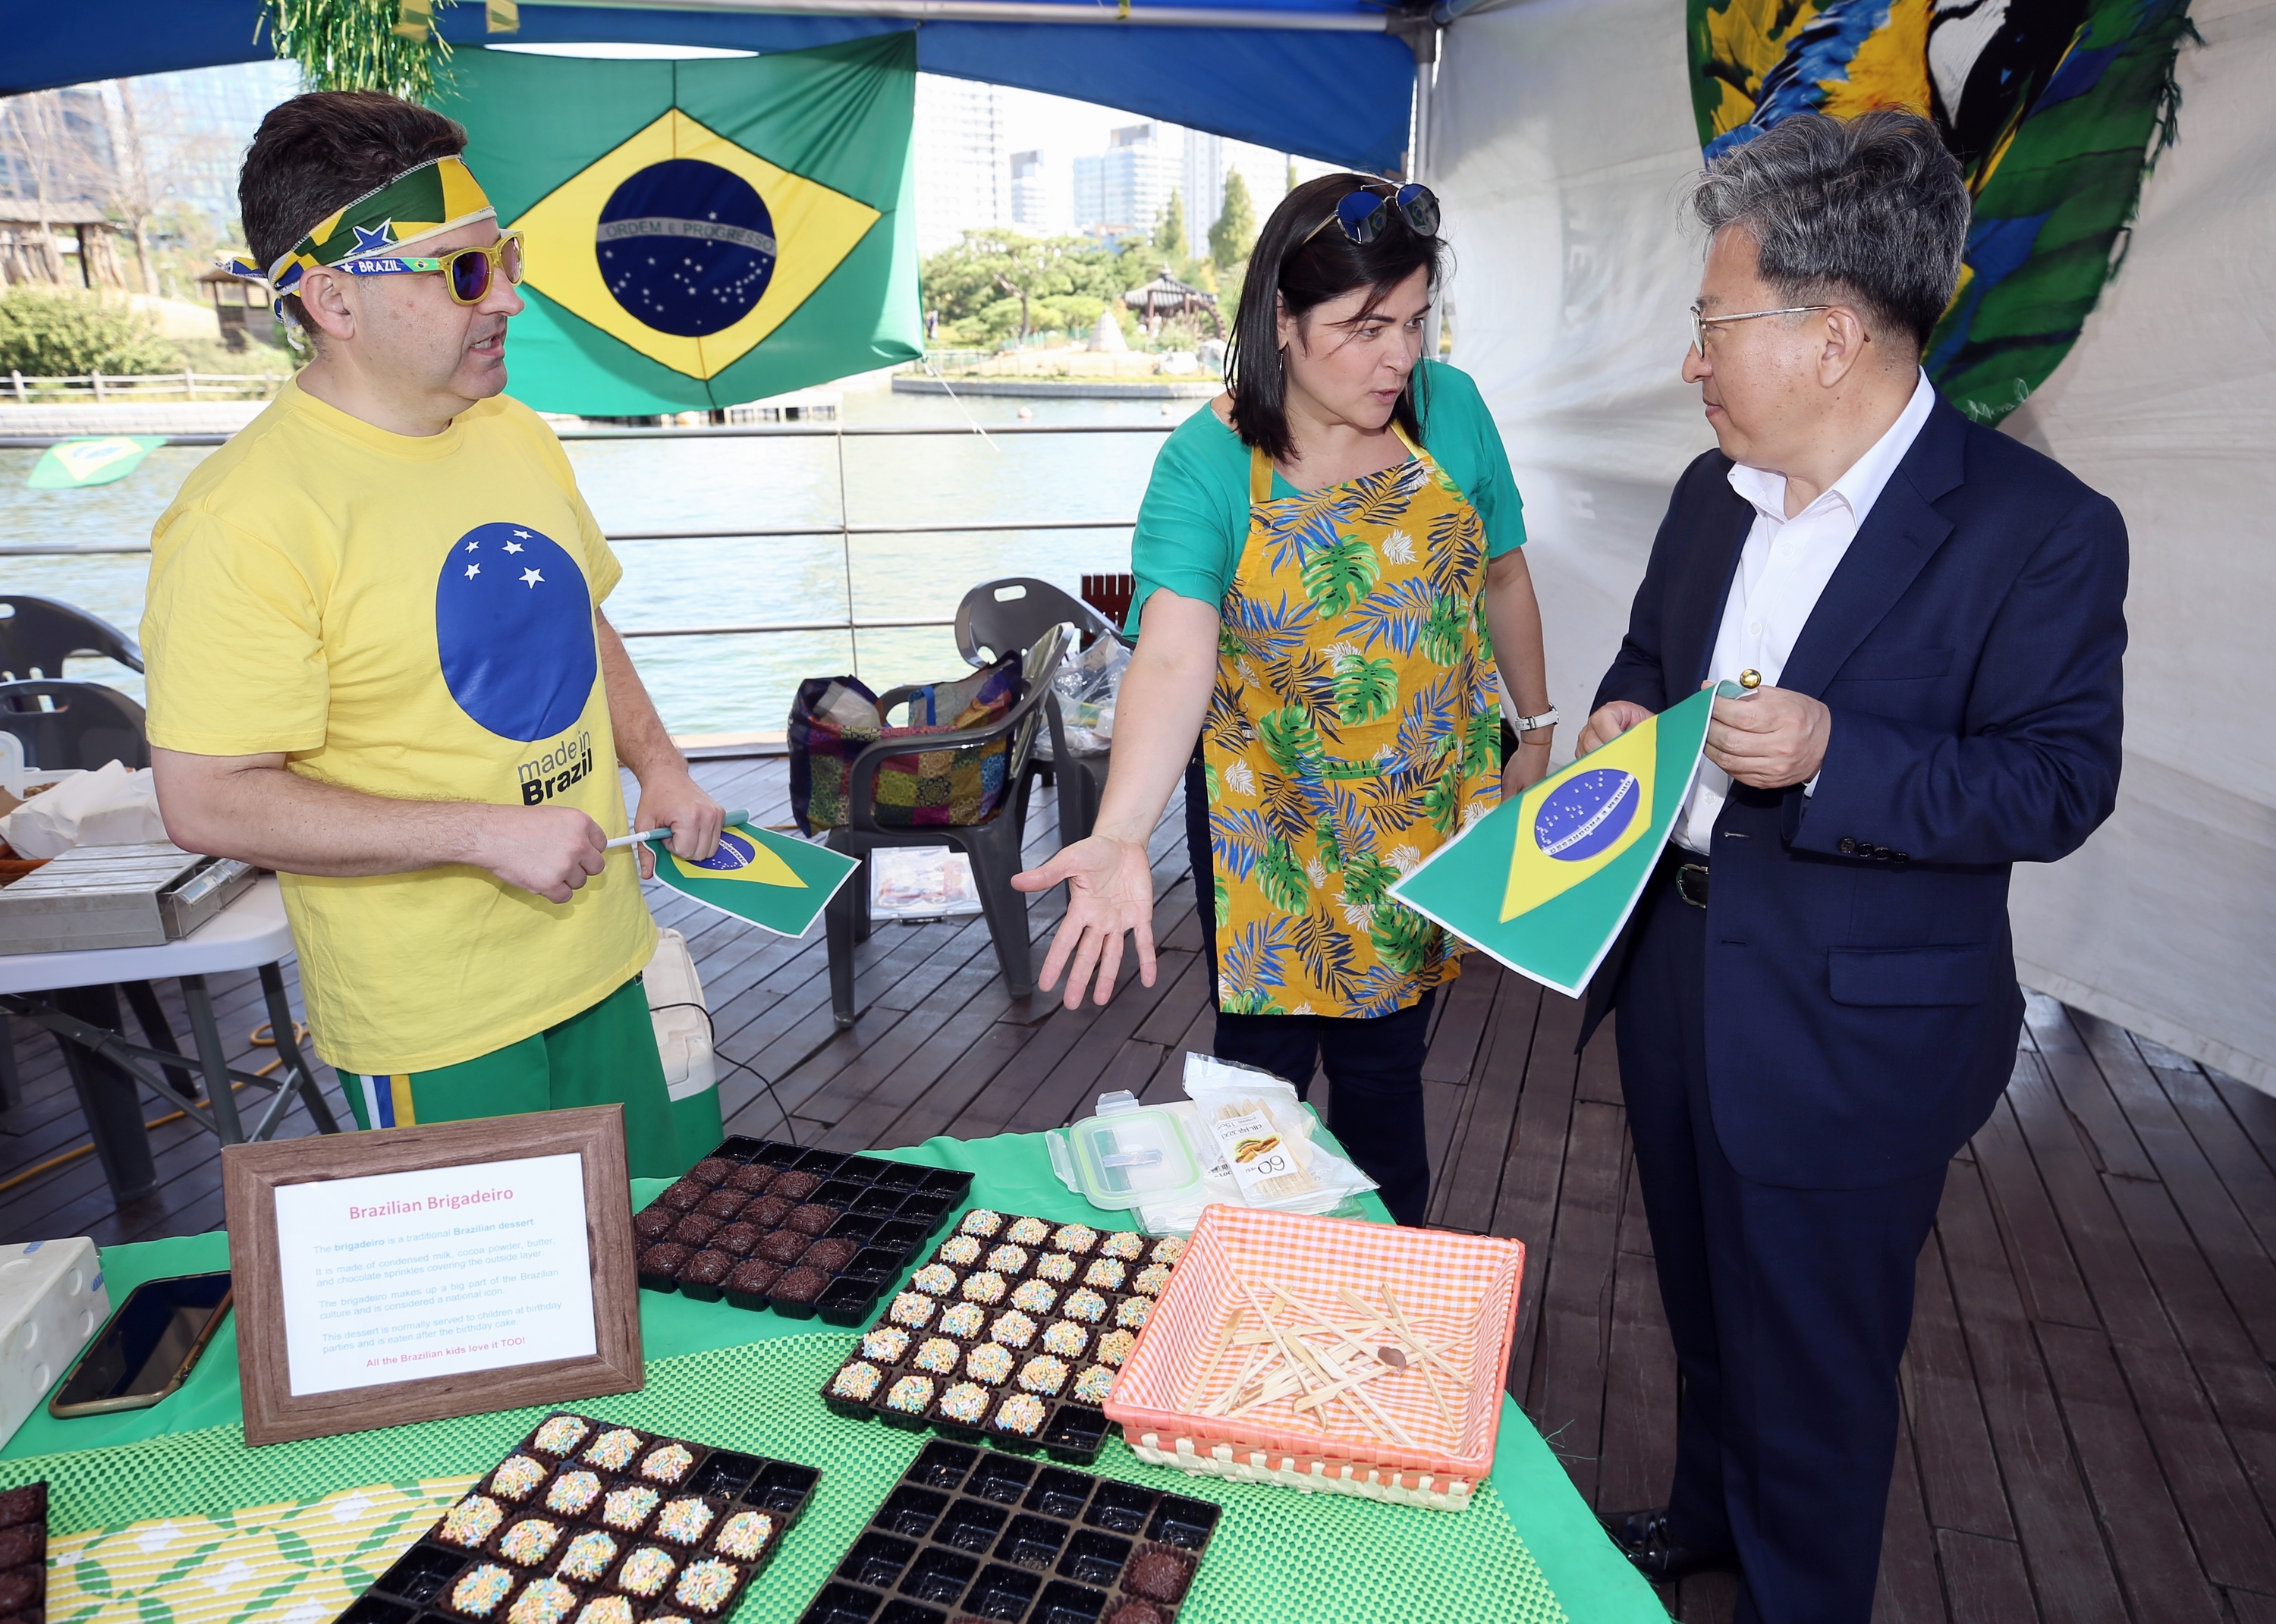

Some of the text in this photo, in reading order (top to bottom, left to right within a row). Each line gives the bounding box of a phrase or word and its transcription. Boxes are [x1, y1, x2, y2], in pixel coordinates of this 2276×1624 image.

[605, 220, 775, 252] ORDEM E PROGRESSO
[358, 259, 401, 273] BRAZIL
[517, 730, 590, 783] made in
[521, 748, 593, 806] Brazil
[1608, 781, 1631, 809] ORDEM
[1549, 816, 1601, 854] PROGRESSO
[349, 1188, 514, 1220] Brazilian Brigadeiro
[313, 1245, 332, 1254] The
[334, 1239, 385, 1252] brigadeiro
[387, 1236, 396, 1245] is
[406, 1229, 451, 1242] traditional
[453, 1224, 496, 1236] Brazilian
[316, 1267, 322, 1276] It
[325, 1267, 333, 1275] is
[336, 1263, 363, 1273] made
[366, 1259, 376, 1270] of
[378, 1253, 429, 1268] condensed
[457, 1247, 485, 1257] cocoa
[316, 1277, 335, 1287] and
[337, 1272, 382, 1284] chocolate
[383, 1266, 425, 1279] sprinkles
[426, 1261, 466, 1272] covering
[468, 1257, 483, 1267] the
[485, 1252, 518, 1264] outside
[318, 1299, 338, 1308] The
[341, 1293, 388, 1306] brigadeiro
[391, 1289, 422, 1299] makes
[425, 1286, 438, 1296] up
[450, 1281, 465, 1292] big
[468, 1278, 487, 1289] part
[489, 1275, 499, 1285] of
[502, 1274, 517, 1283] the
[520, 1269, 559, 1281] Brazilian
[319, 1309, 351, 1320] culture
[354, 1304, 372, 1315] and
[384, 1296, 435, 1311] considered
[445, 1289, 482, 1302] national
[322, 1333, 342, 1342] This
[344, 1327, 379, 1339] dessert
[391, 1320, 431, 1333] normally
[432, 1315, 464, 1327] served
[466, 1313, 476, 1322] to
[477, 1308, 513, 1320] children
[515, 1305, 524, 1315] at
[526, 1302, 562, 1313] birthday
[322, 1343, 355, 1355] parties
[357, 1337, 375, 1349] and
[387, 1334, 413, 1344] eaten
[416, 1330, 437, 1340] after
[439, 1327, 454, 1337] the
[455, 1322, 492, 1334] birthday
[366, 1337, 525, 1368] All the Brazilian kids love it TOO!
